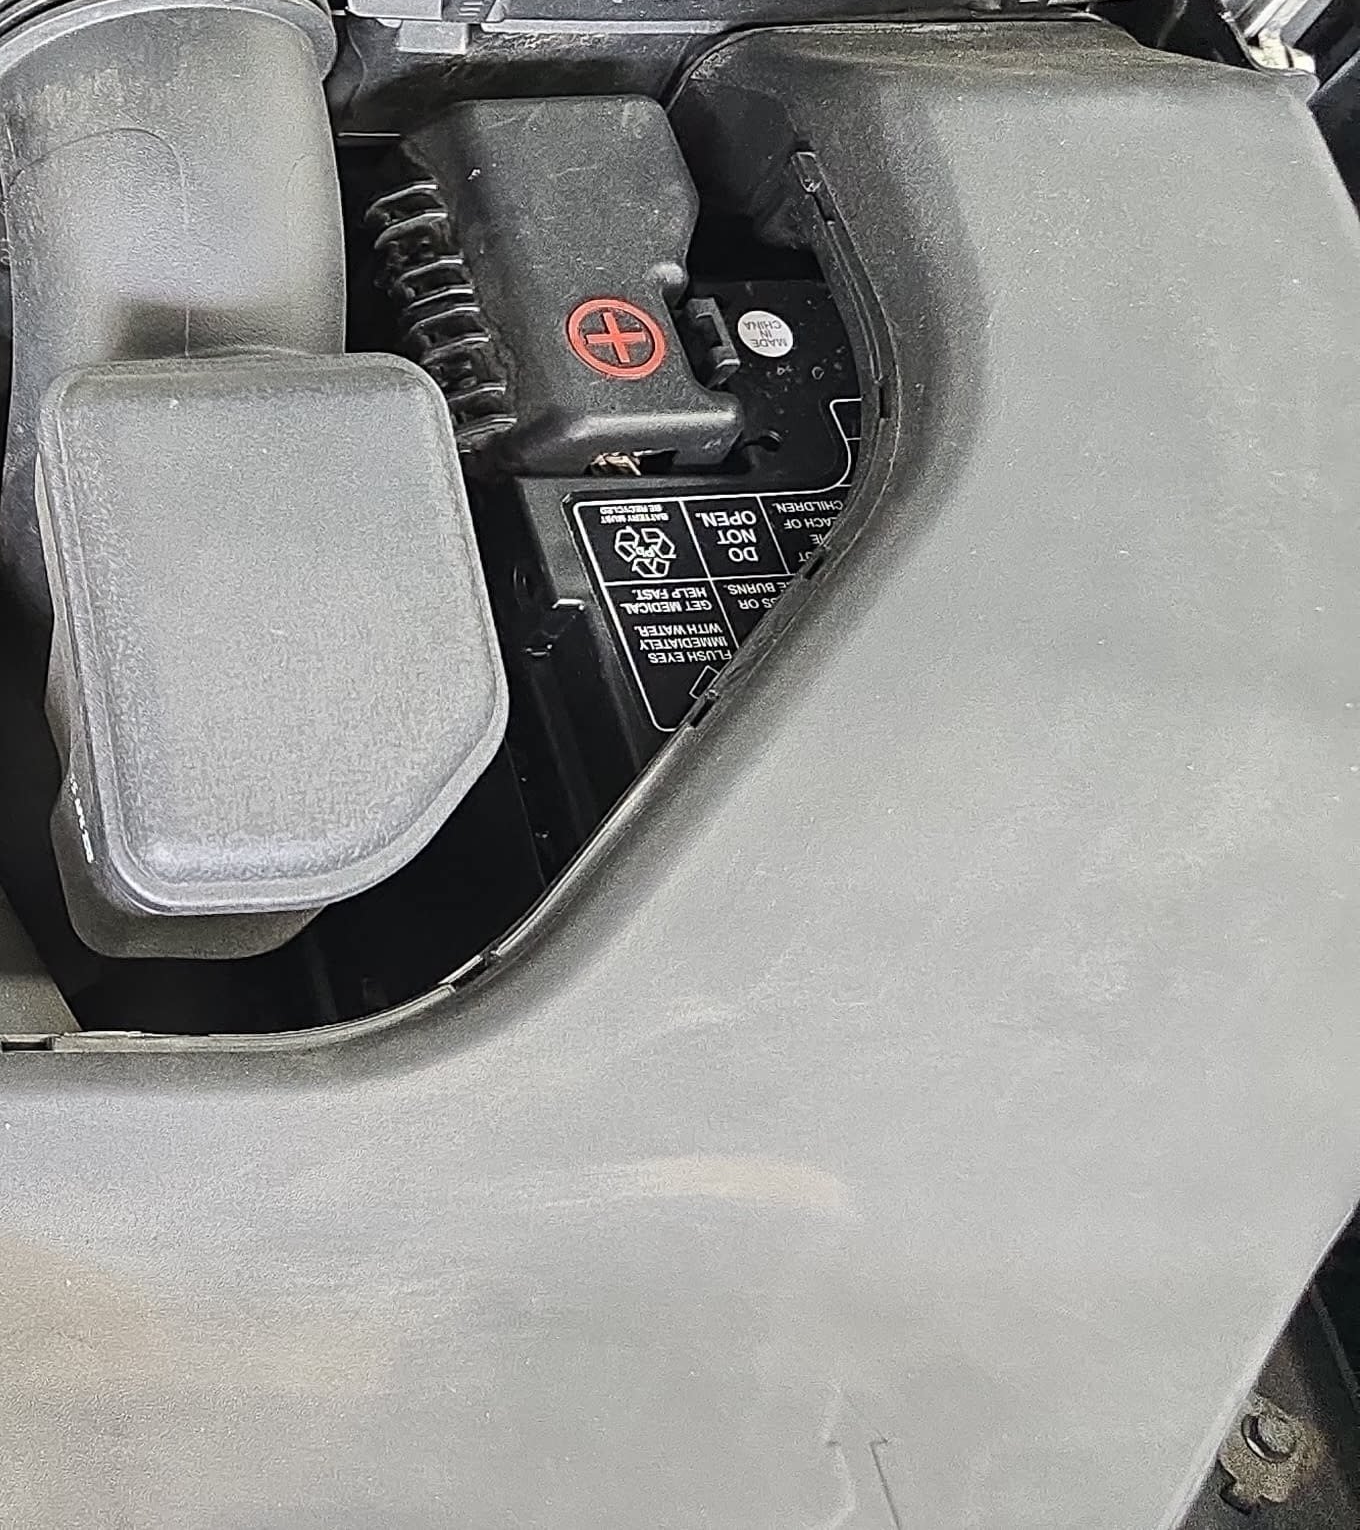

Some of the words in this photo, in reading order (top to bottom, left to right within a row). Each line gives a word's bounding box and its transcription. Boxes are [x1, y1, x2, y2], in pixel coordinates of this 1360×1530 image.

[743, 319, 782, 330] CHINA
[759, 329, 772, 339] IN
[750, 338, 787, 348] MADE
[599, 505, 647, 515] RECYCLED
[773, 500, 844, 514] CHILDREN.
[600, 514, 625, 524] MUST
[627, 511, 669, 522] BATTERY
[694, 510, 756, 528] OPEN.
[783, 518, 803, 529] OF
[805, 517, 837, 529] ACH
[715, 528, 756, 545] NOT
[728, 545, 759, 562] DO
[633, 588, 669, 601] FAST.
[671, 586, 708, 600] HELP
[726, 582, 775, 596] BURNS.
[619, 601, 682, 615] MEDICAL
[684, 599, 712, 612] GET
[738, 597, 759, 610] OR
[633, 623, 685, 637] WATER.
[686, 622, 722, 636] WITH
[639, 635, 728, 651] IMMEDIATELY
[647, 651, 685, 665] EYES
[686, 648, 732, 662] FLUSH
